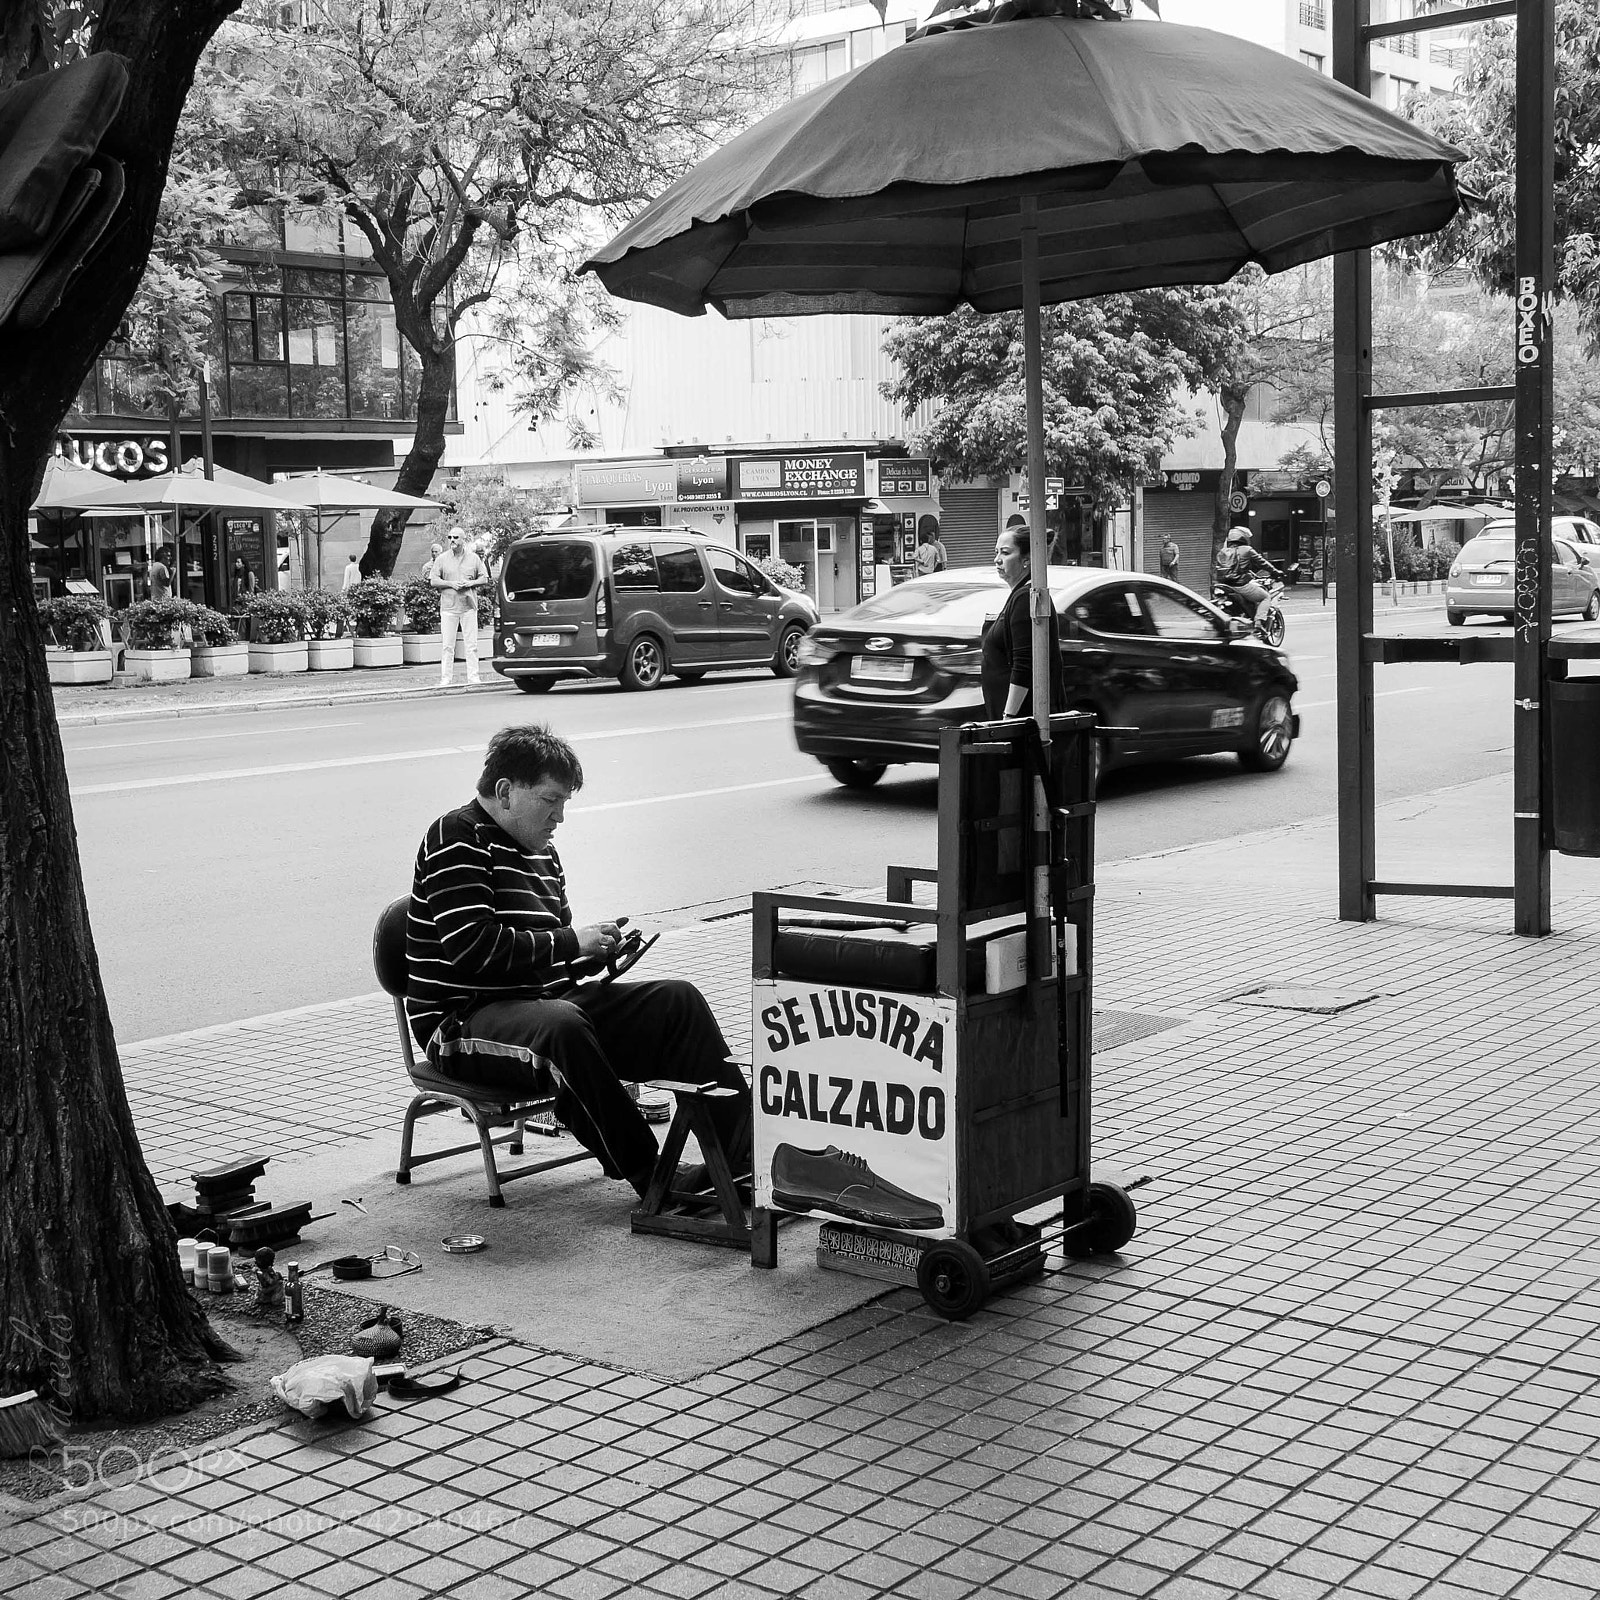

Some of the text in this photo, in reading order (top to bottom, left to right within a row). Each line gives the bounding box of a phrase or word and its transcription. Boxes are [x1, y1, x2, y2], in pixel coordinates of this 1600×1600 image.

[1517, 276, 1539, 363] BOXEO
[784, 458, 833, 470] MONEY
[692, 475, 715, 487] Lyon
[784, 468, 858, 482] EXCHANGE
[645, 479, 674, 496] Lyon
[741, 489, 808, 498] WWW.CAMBIOSLYON.CL
[681, 505, 715, 513] PROVIDENCIA
[760, 989, 944, 1073] SE LUSTRA
[759, 1064, 946, 1141] CALZADO
